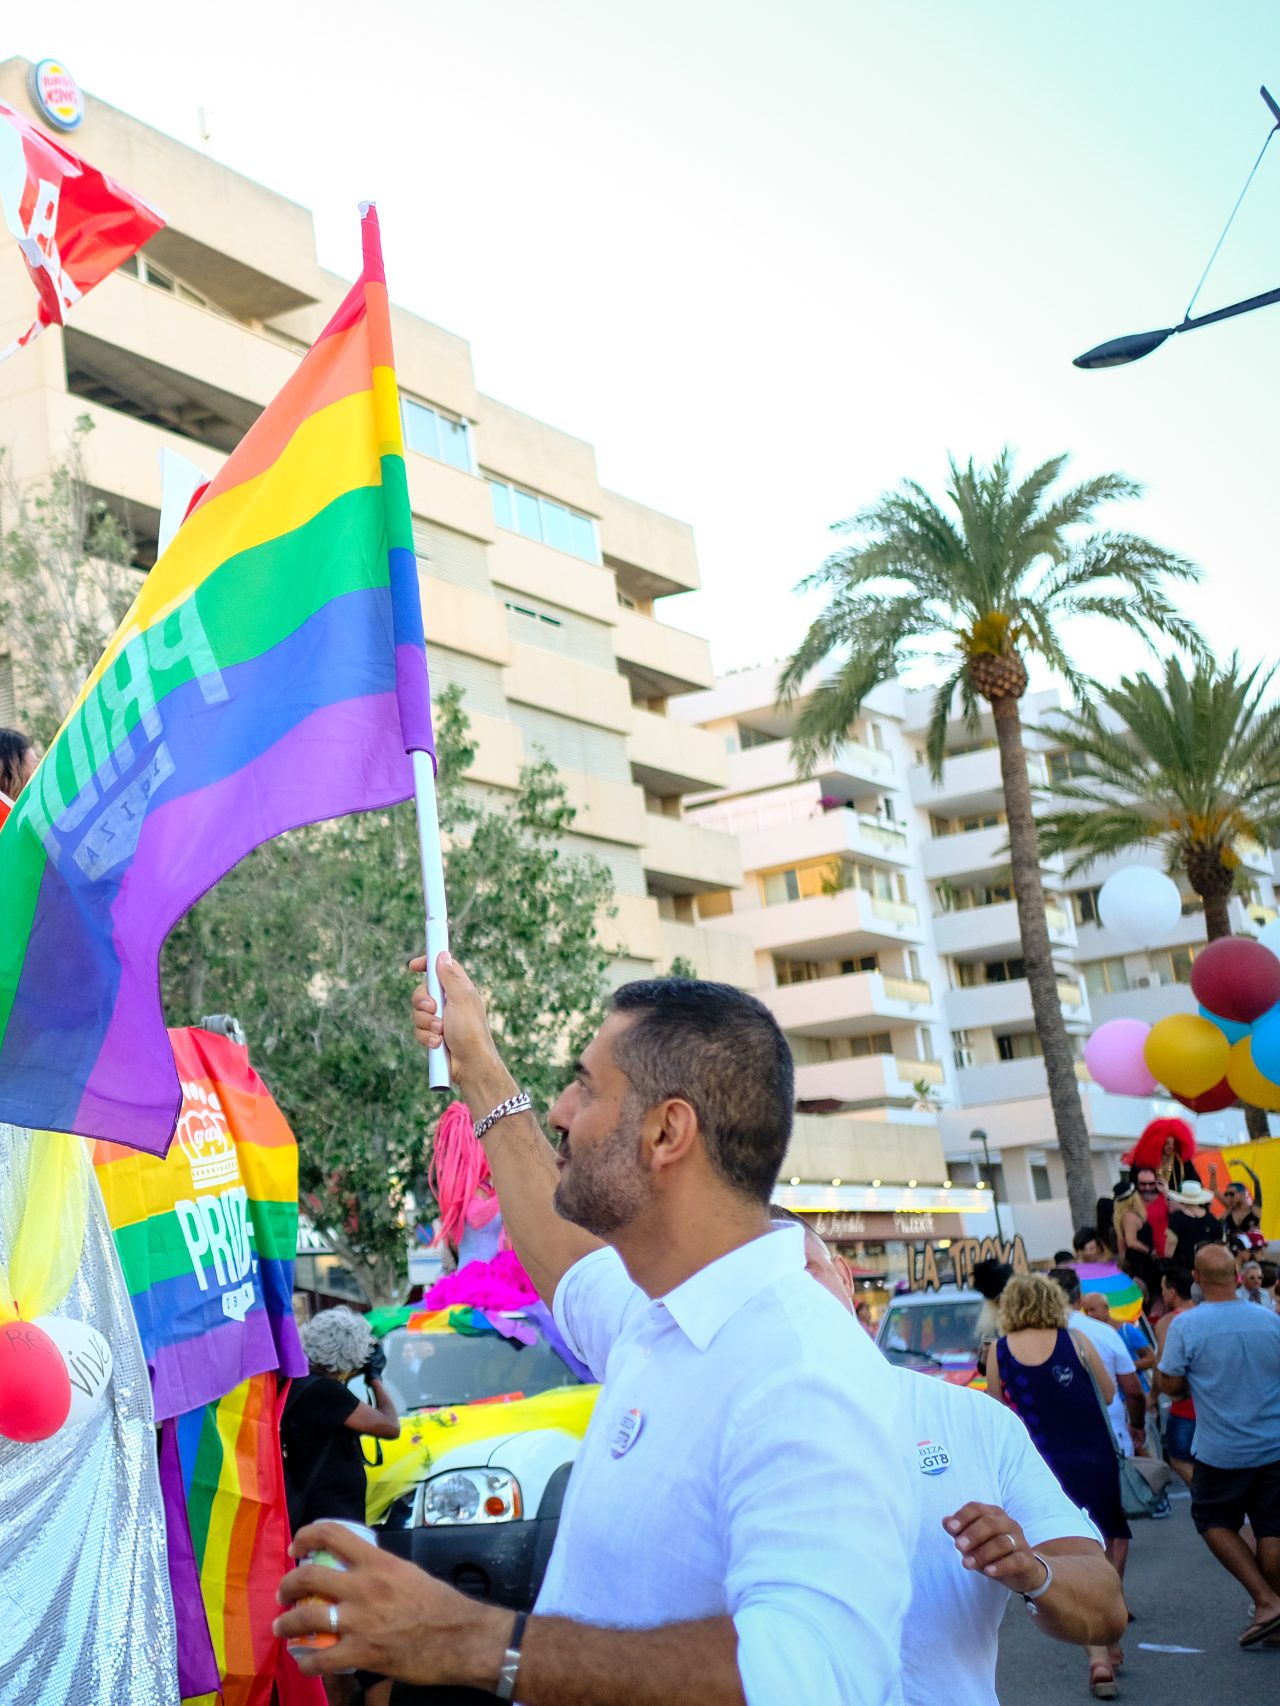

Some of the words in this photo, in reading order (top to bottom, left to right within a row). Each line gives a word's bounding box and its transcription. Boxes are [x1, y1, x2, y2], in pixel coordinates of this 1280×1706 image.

[174, 1185, 258, 1291] PRID
[908, 1241, 941, 1294] LA
[918, 1445, 945, 1456] BIZA
